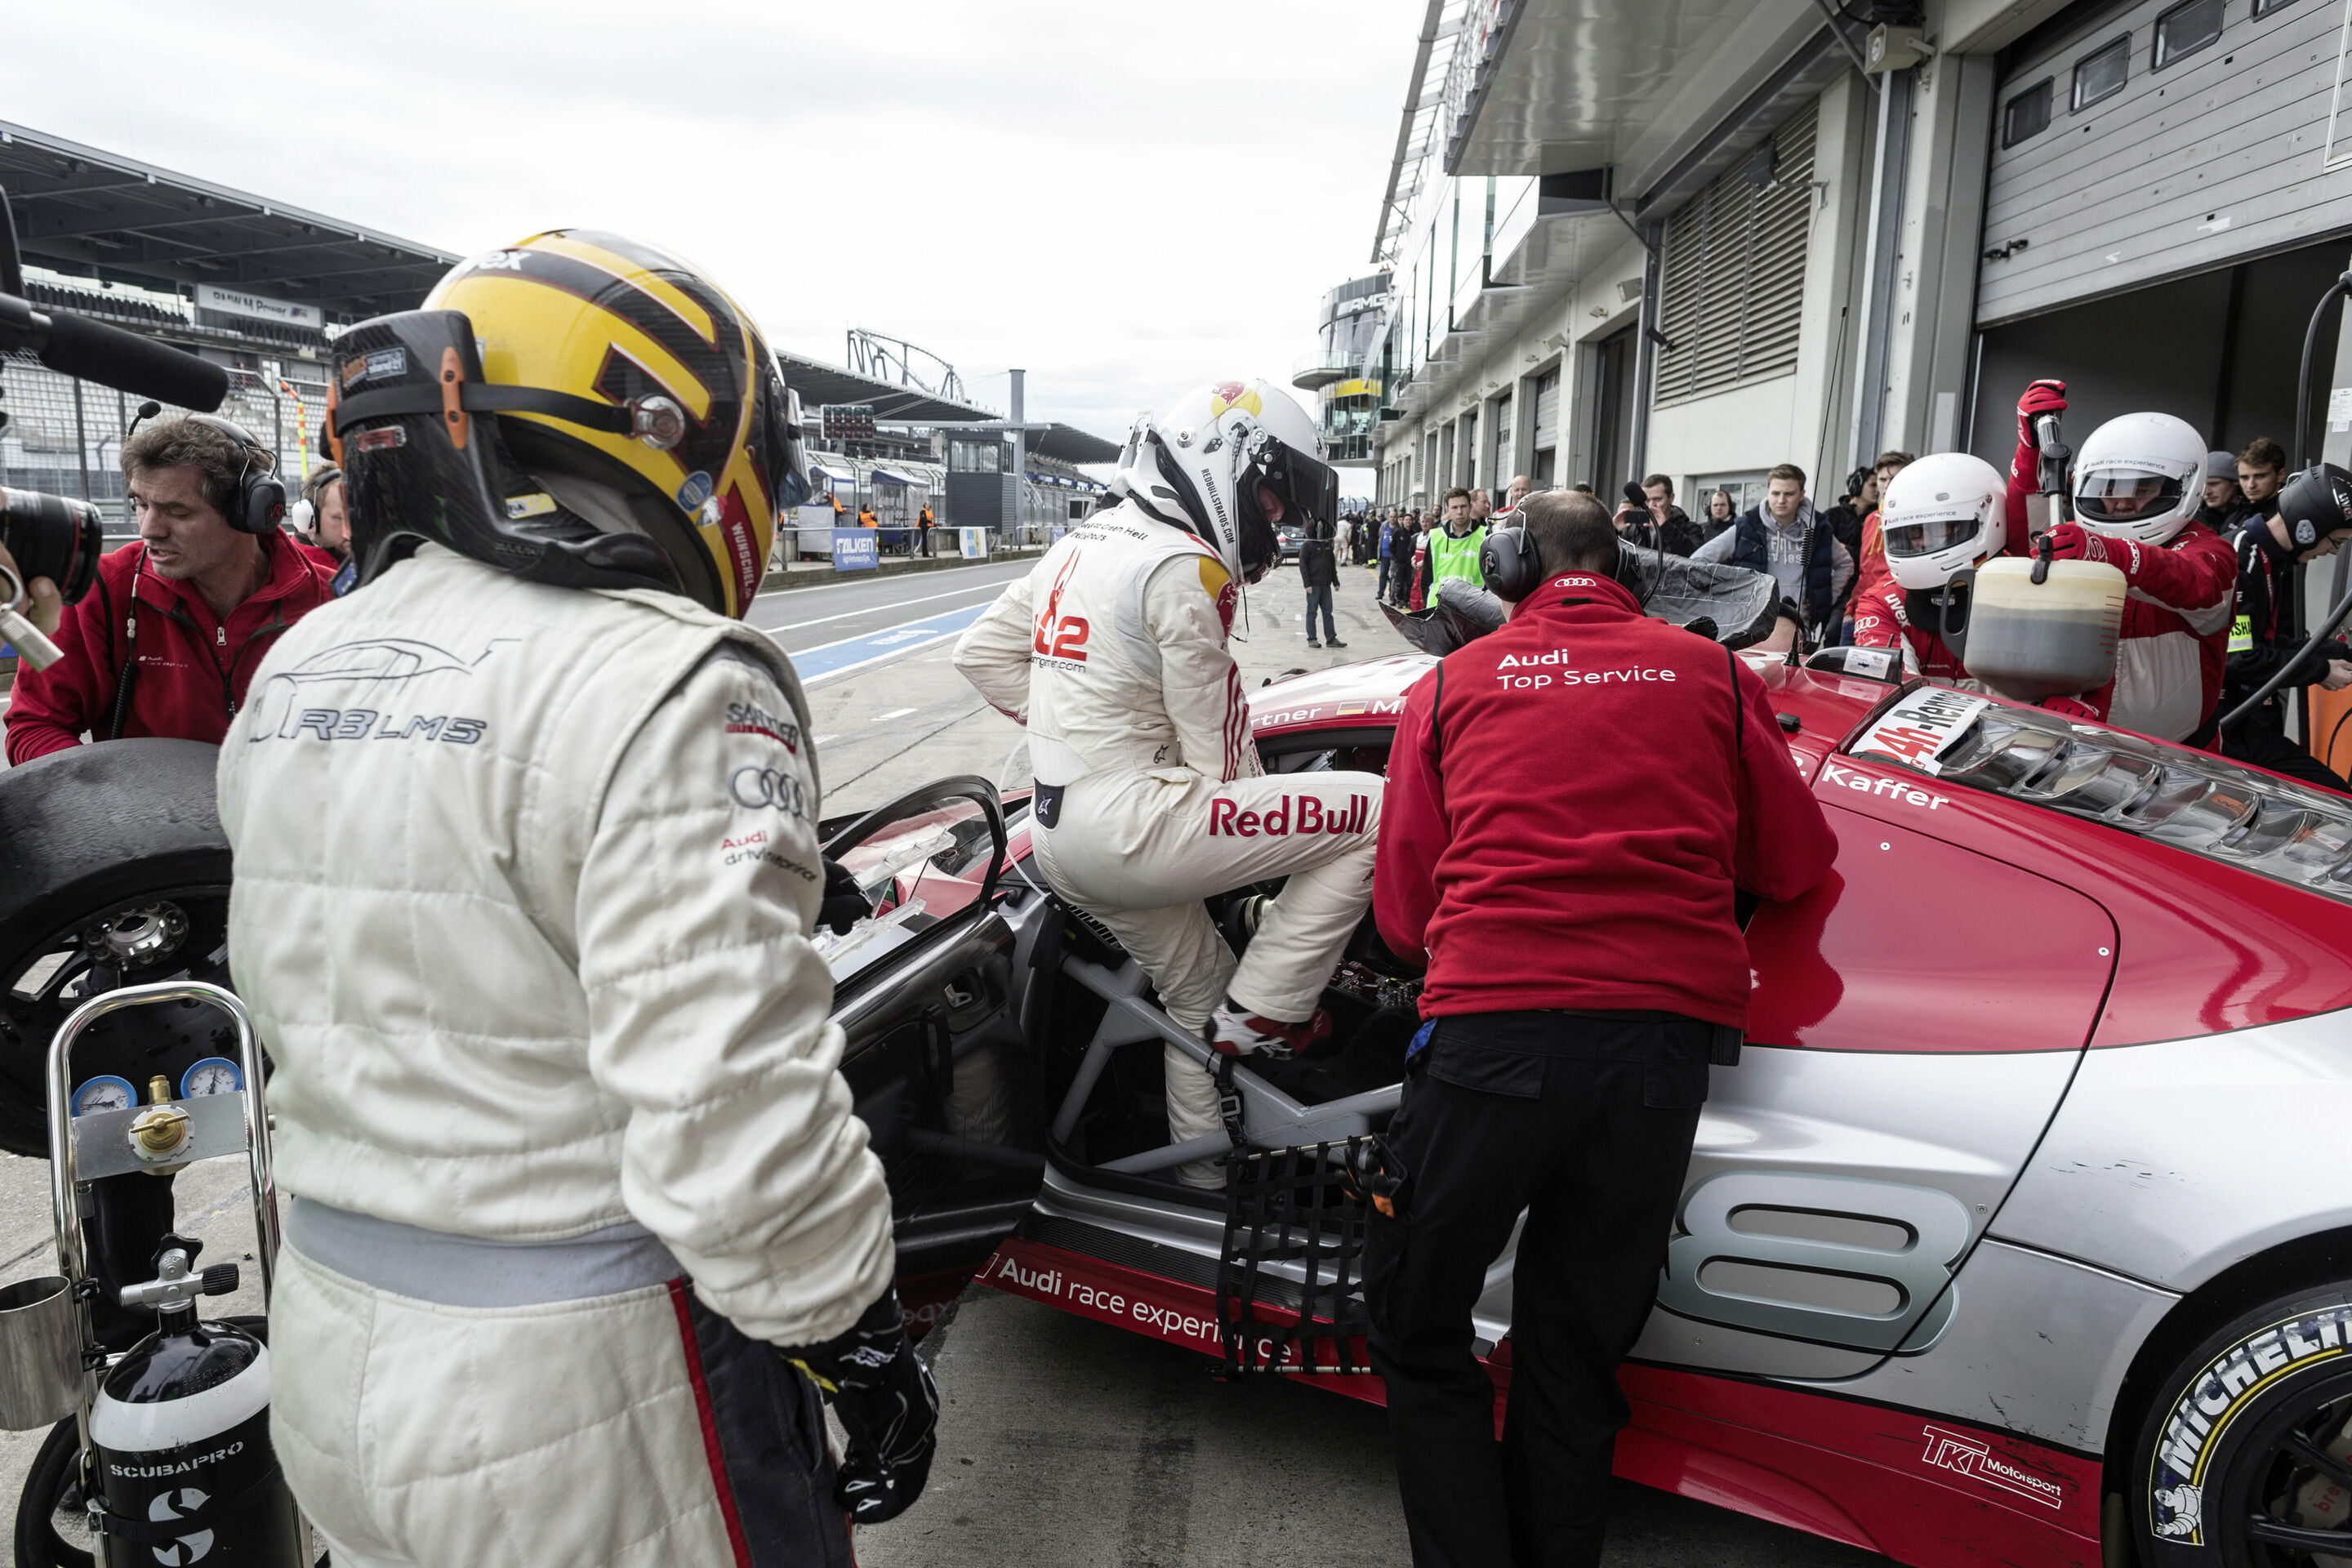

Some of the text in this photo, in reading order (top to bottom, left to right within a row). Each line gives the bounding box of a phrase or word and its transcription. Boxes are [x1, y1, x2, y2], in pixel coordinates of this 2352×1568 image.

[1350, 292, 1388, 312] AMG
[2124, 459, 2166, 470] experience
[1201, 468, 1235, 544] REDBULLSTRATOS.COM
[1915, 510, 1957, 519] experience
[836, 537, 874, 554] FALKEN
[1124, 527, 1149, 541] Hell
[732, 522, 755, 587] WUNSCHEL
[1884, 593, 1911, 628] uvex
[1497, 648, 1569, 670] Audi
[1496, 665, 1677, 690] Top Service
[290, 708, 488, 745] R8 LMS
[1822, 764, 1950, 810] Kaffer
[1209, 794, 1369, 838] Red Bull
[721, 830, 768, 850] Audi
[1656, 1169, 1973, 1358] 8
[997, 1258, 1292, 1364] Audi race experince
[110, 1441, 243, 1478] SCUBAPRO
[1987, 1458, 2061, 1496] Motorsport
